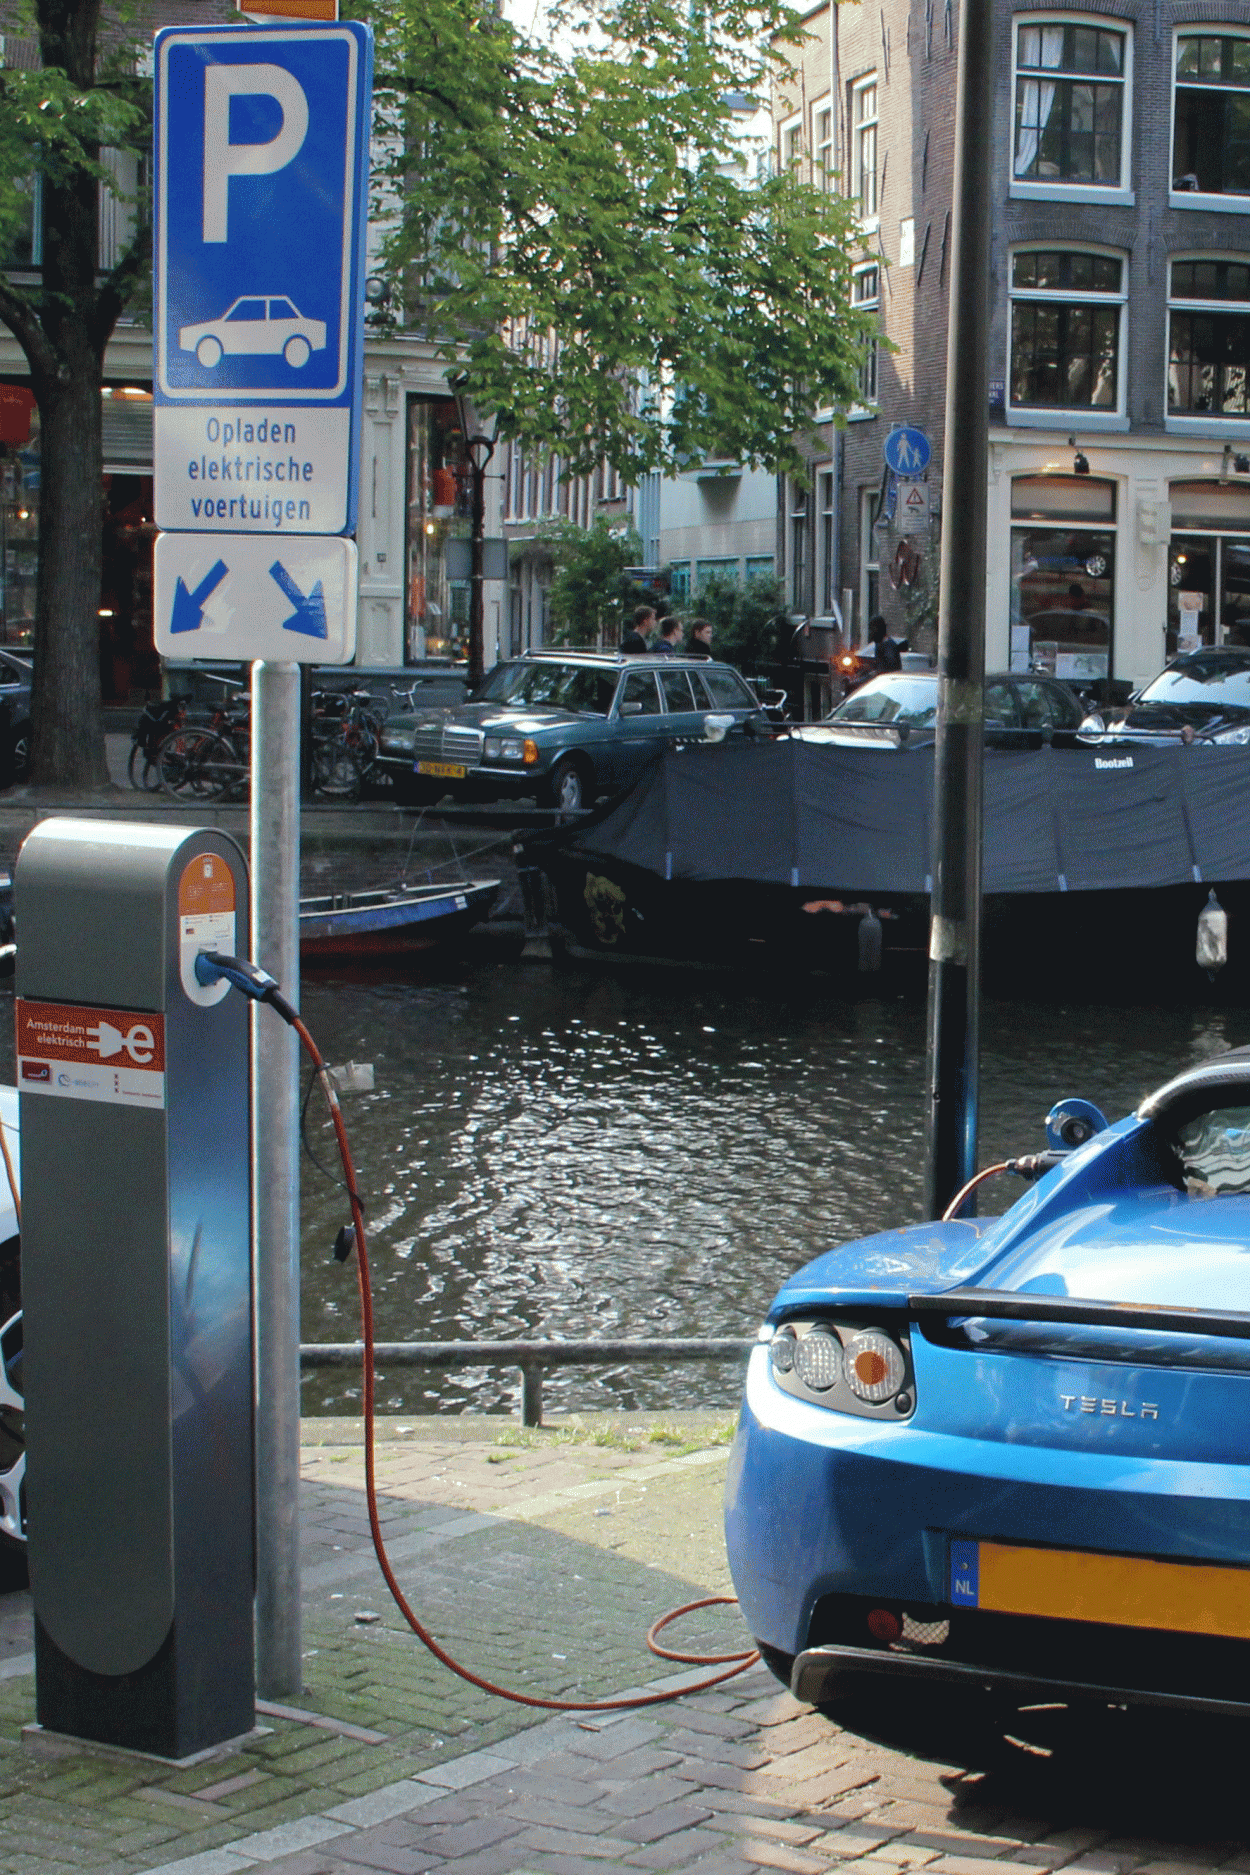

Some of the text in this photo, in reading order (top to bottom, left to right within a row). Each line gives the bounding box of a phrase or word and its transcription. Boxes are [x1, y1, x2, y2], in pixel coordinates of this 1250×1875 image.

[203, 63, 309, 244] P
[207, 417, 296, 447] Opladen
[188, 455, 313, 481] elektrische
[191, 493, 311, 527] voertuigen
[1094, 756, 1134, 770] Bootzeil
[26, 1018, 85, 1035] Amsterdam
[37, 1032, 85, 1048] elektrisch
[1060, 1394, 1160, 1420] TESLA
[955, 1579, 975, 1596] NL
